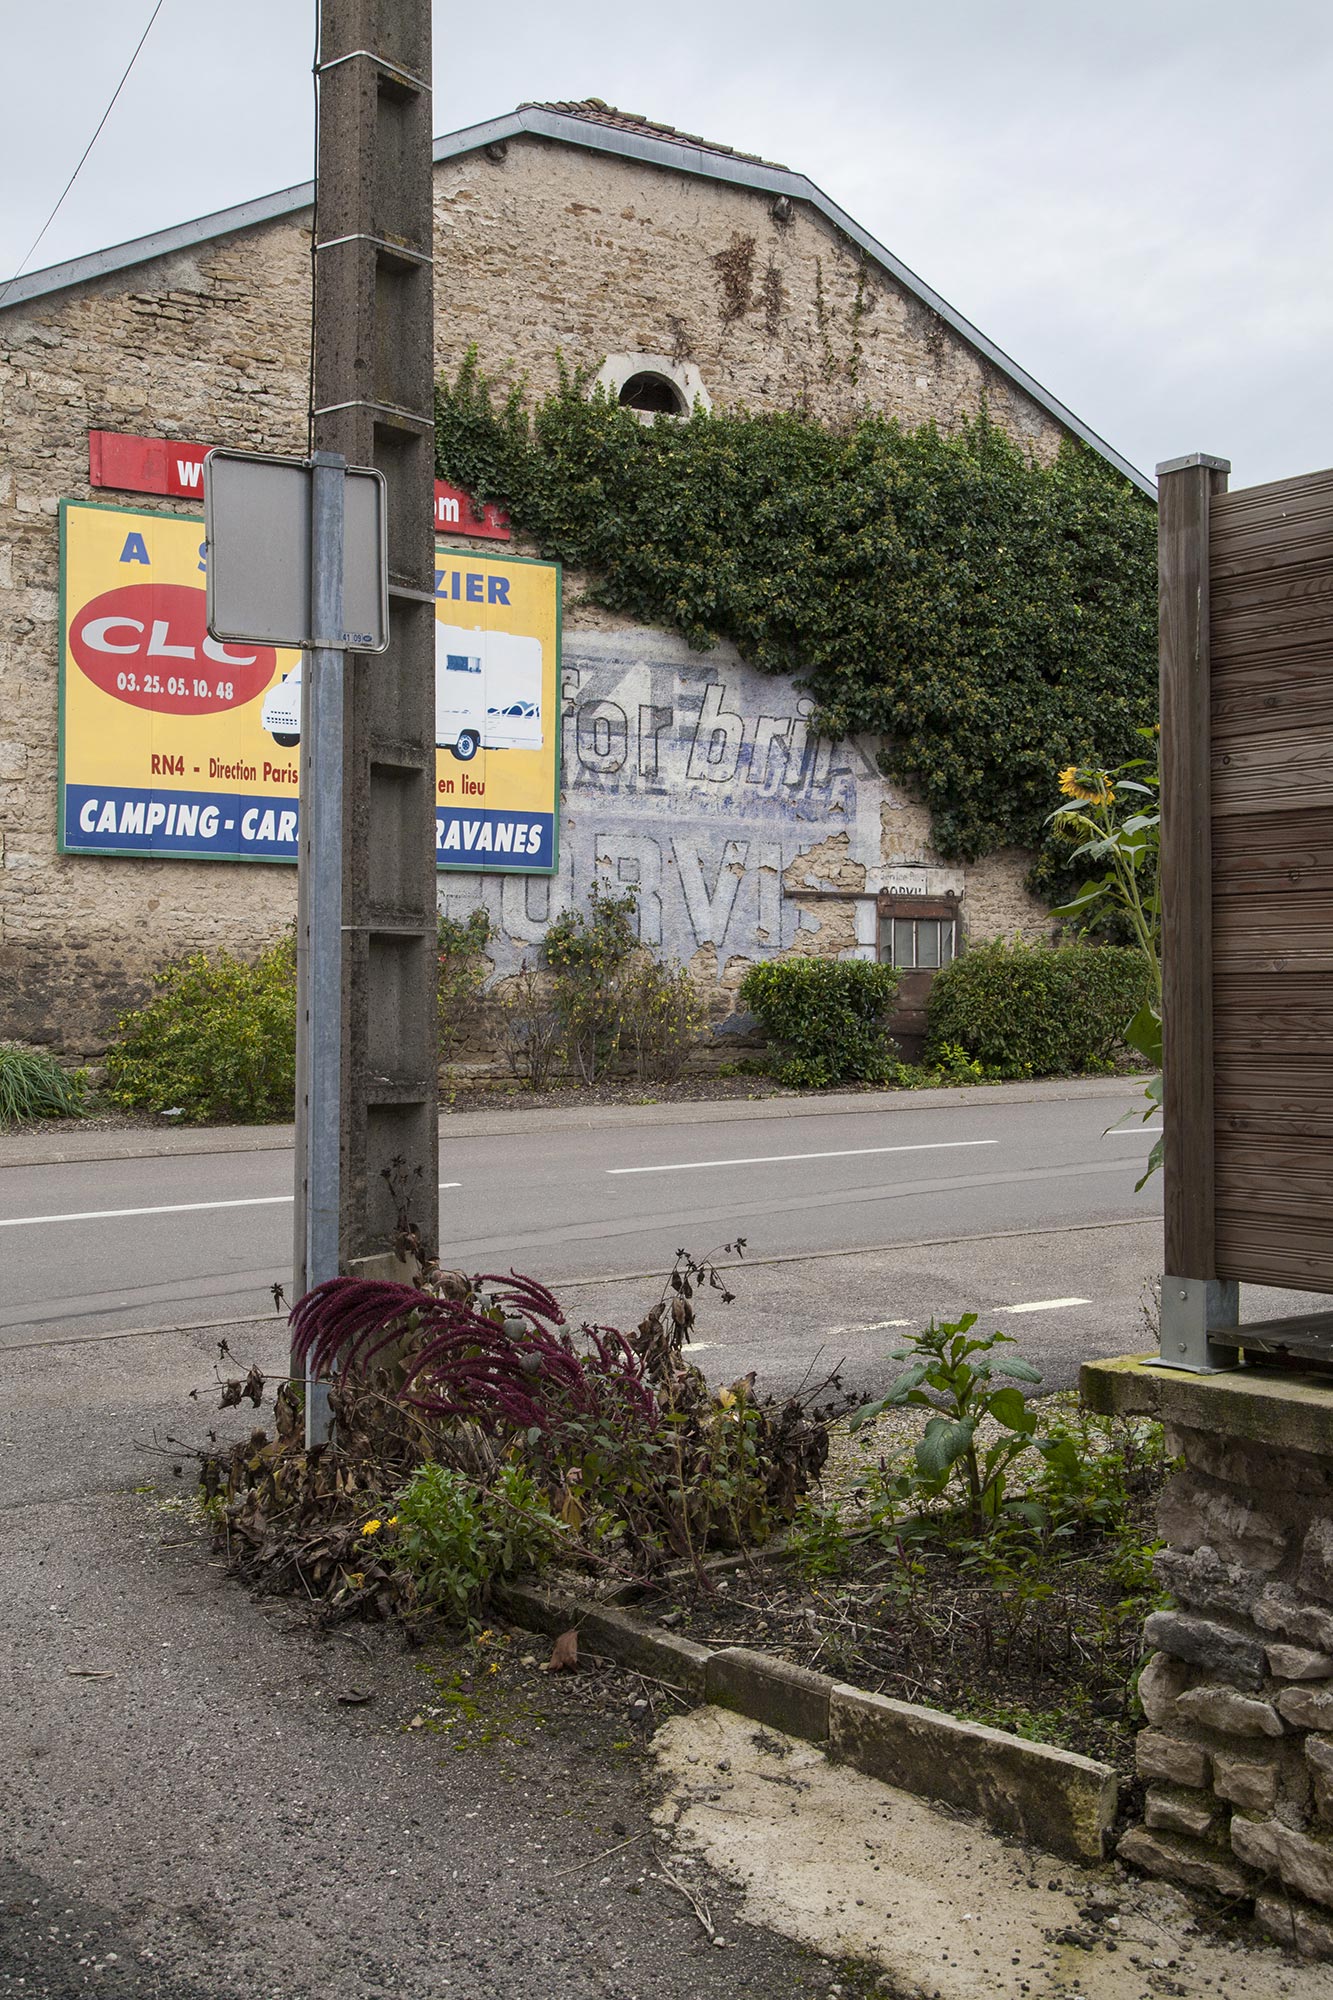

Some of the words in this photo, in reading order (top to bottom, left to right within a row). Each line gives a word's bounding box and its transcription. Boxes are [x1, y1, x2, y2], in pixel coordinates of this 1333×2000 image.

[119, 531, 151, 565] A
[151, 754, 185, 776] RN4
[209, 757, 257, 781] Direction
[263, 762, 299, 784] Paris
[438, 779, 454, 794] en
[461, 773, 485, 796] lieu
